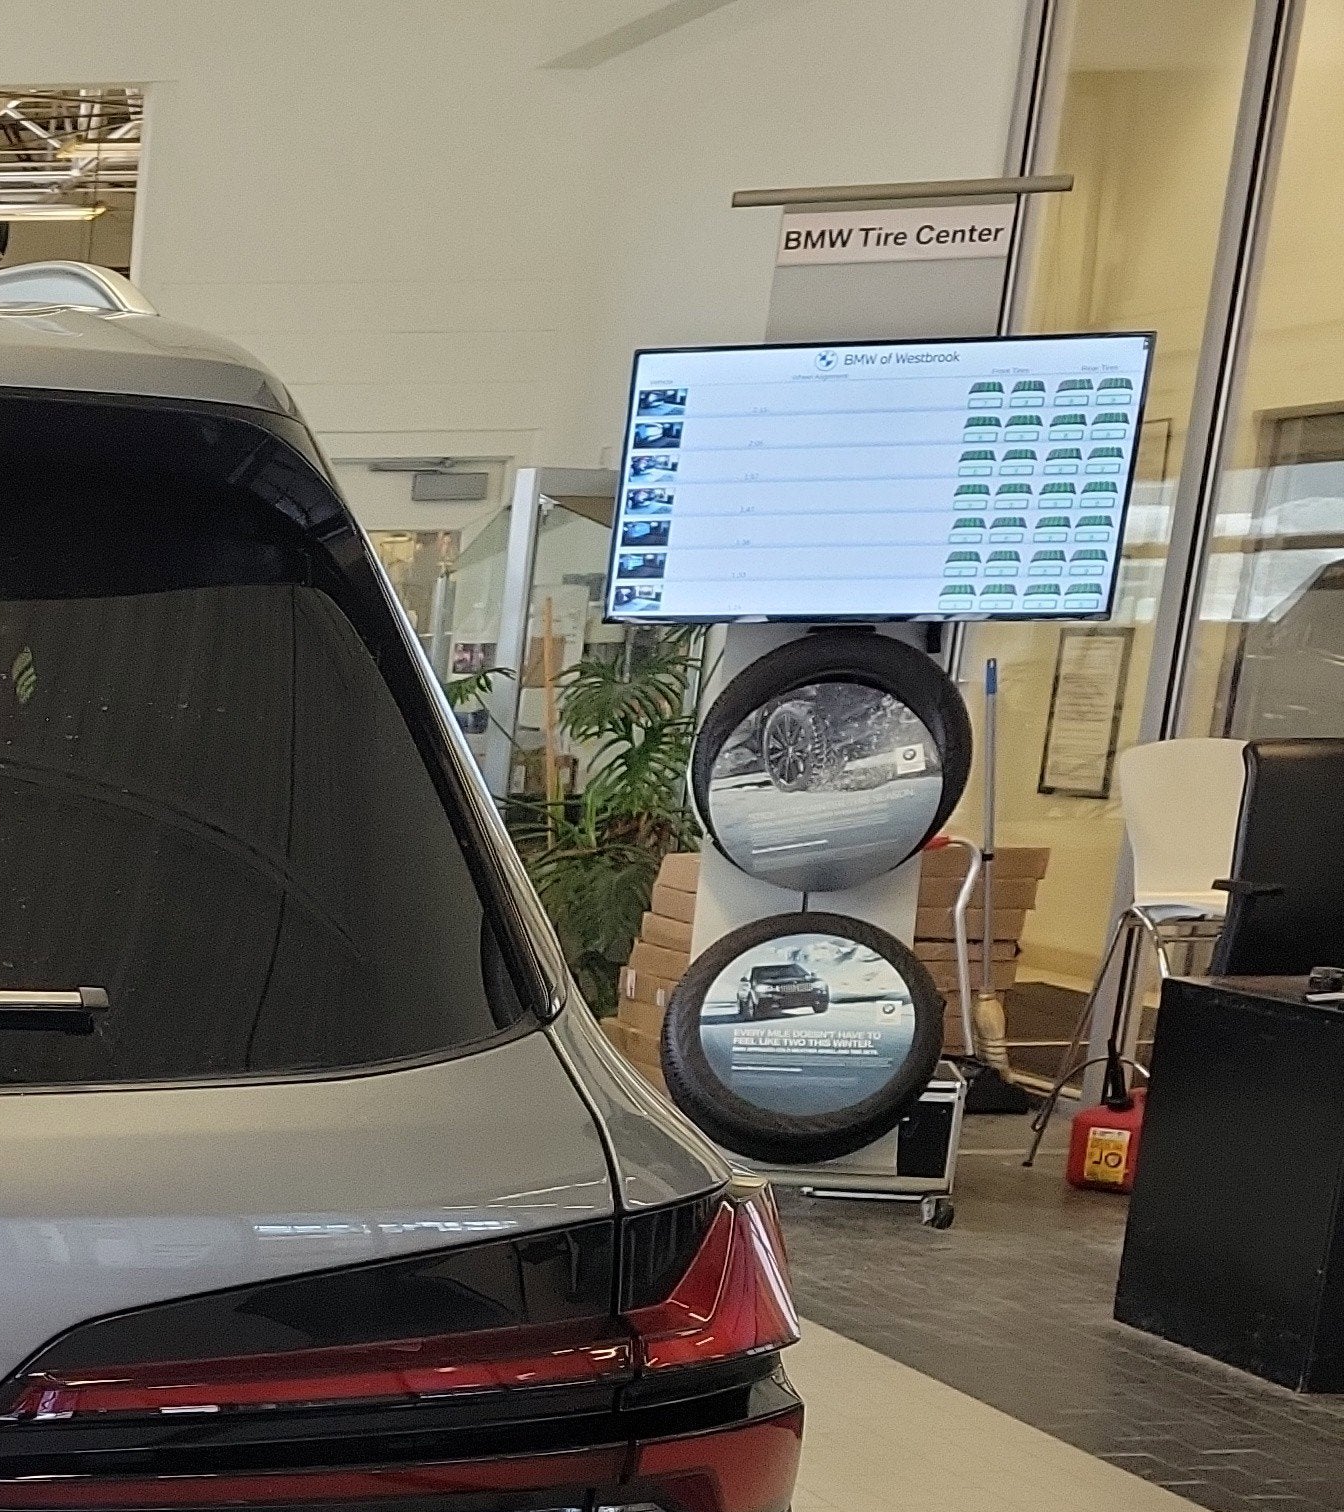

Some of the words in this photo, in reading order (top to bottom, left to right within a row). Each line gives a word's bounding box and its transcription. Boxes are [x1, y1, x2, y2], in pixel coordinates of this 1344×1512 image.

[784, 228, 854, 250] BMW
[859, 226, 908, 247] Tire
[916, 224, 1005, 245] Center
[844, 353, 878, 366] BMW
[880, 352, 893, 364] of
[896, 351, 960, 364] Westbrook
